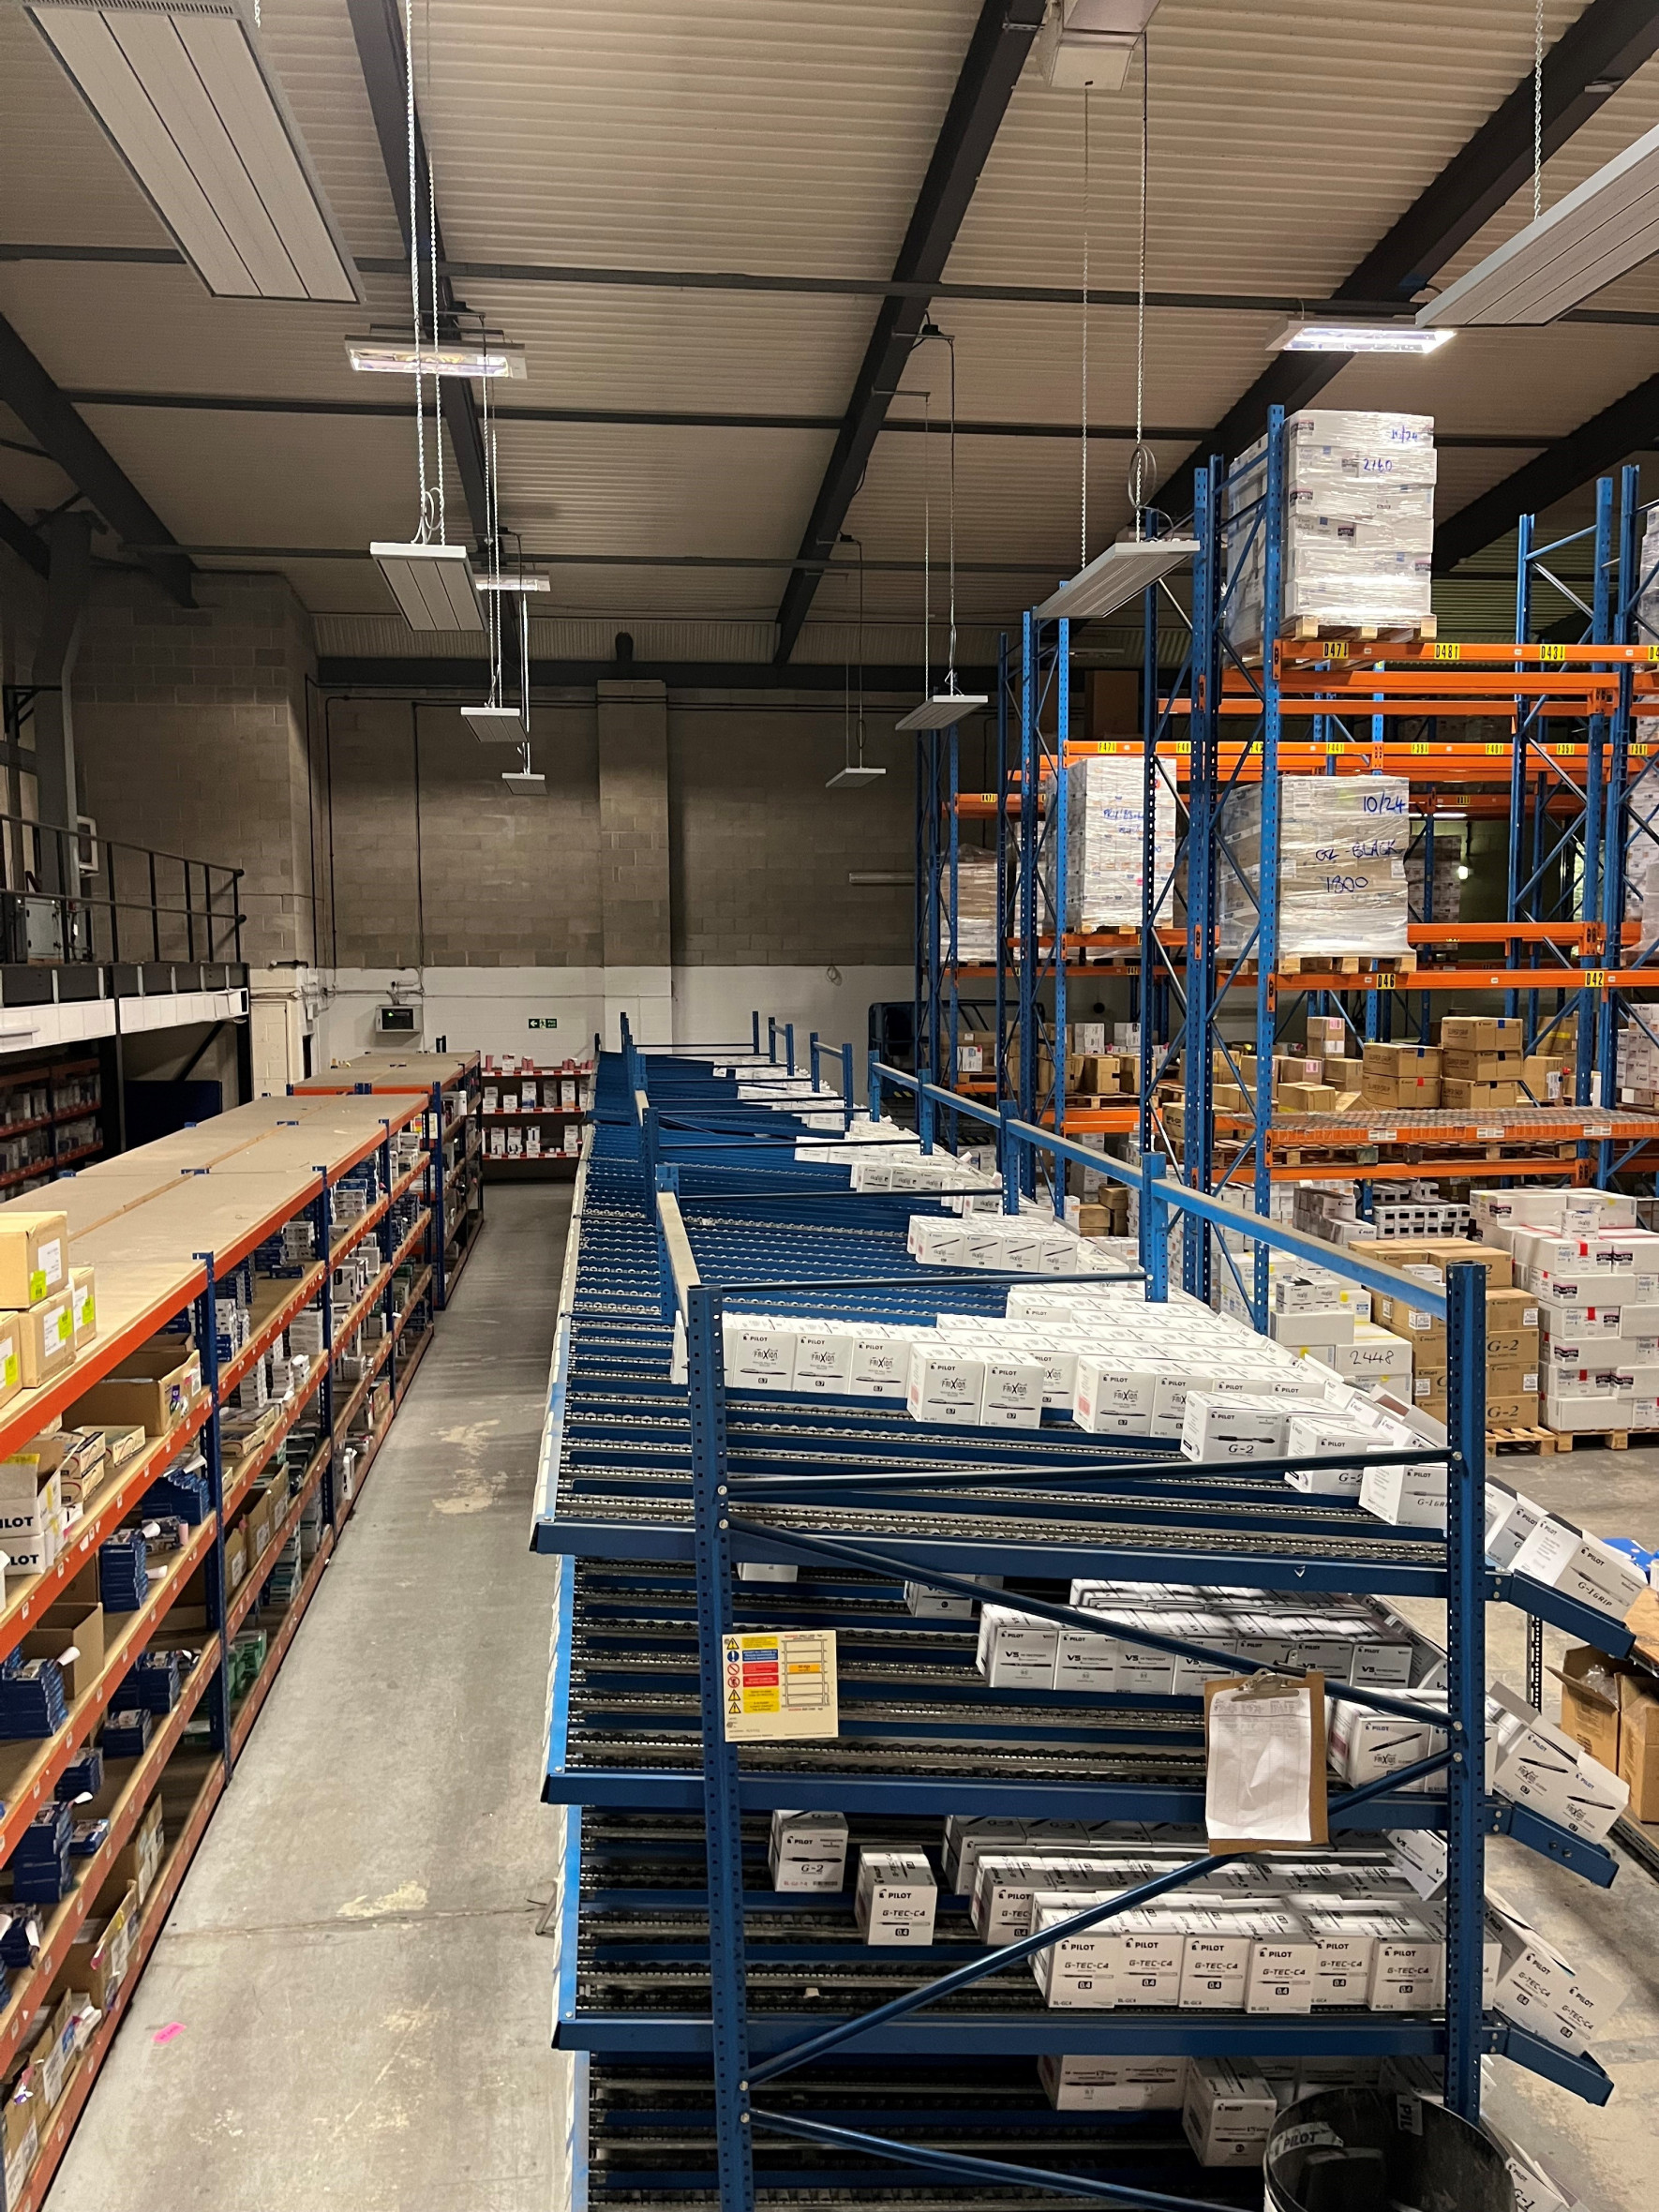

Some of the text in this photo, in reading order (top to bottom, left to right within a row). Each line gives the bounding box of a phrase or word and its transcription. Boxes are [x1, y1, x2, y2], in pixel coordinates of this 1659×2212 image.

[1363, 458, 1393, 472] 2160
[1323, 643, 1341, 658] D47
[1435, 645, 1453, 659] D48
[1540, 646, 1559, 660] D43
[1363, 791, 1405, 814] 10/24
[1326, 875, 1368, 893] 1800
[1377, 974, 1395, 988] D46
[1585, 972, 1604, 986] D42
[1487, 1339, 1519, 1353] G-2
[1349, 1350, 1395, 1365] 2448
[1487, 1405, 1519, 1417] G-2
[1228, 1444, 1254, 1454] G-2
[0, 1517, 34, 1529] ILOT
[1521, 1513, 1538, 1526] PILOT
[10, 1554, 39, 1566] LOT
[1587, 1552, 1606, 1566] PILOT
[1592, 1592, 1613, 1607] GRIP
[1532, 1742, 1547, 1752] PILOT
[1580, 1777, 1595, 1789] PILOT
[800, 1863, 824, 1873] G-2
[896, 1928, 909, 1936] 0.4
[1532, 1960, 1551, 1975] PILOT
[1399, 1985, 1412, 1994] 0.4
[1576, 1993, 1594, 2009] PILOT
[1283, 2132, 1317, 2150] PILOT
